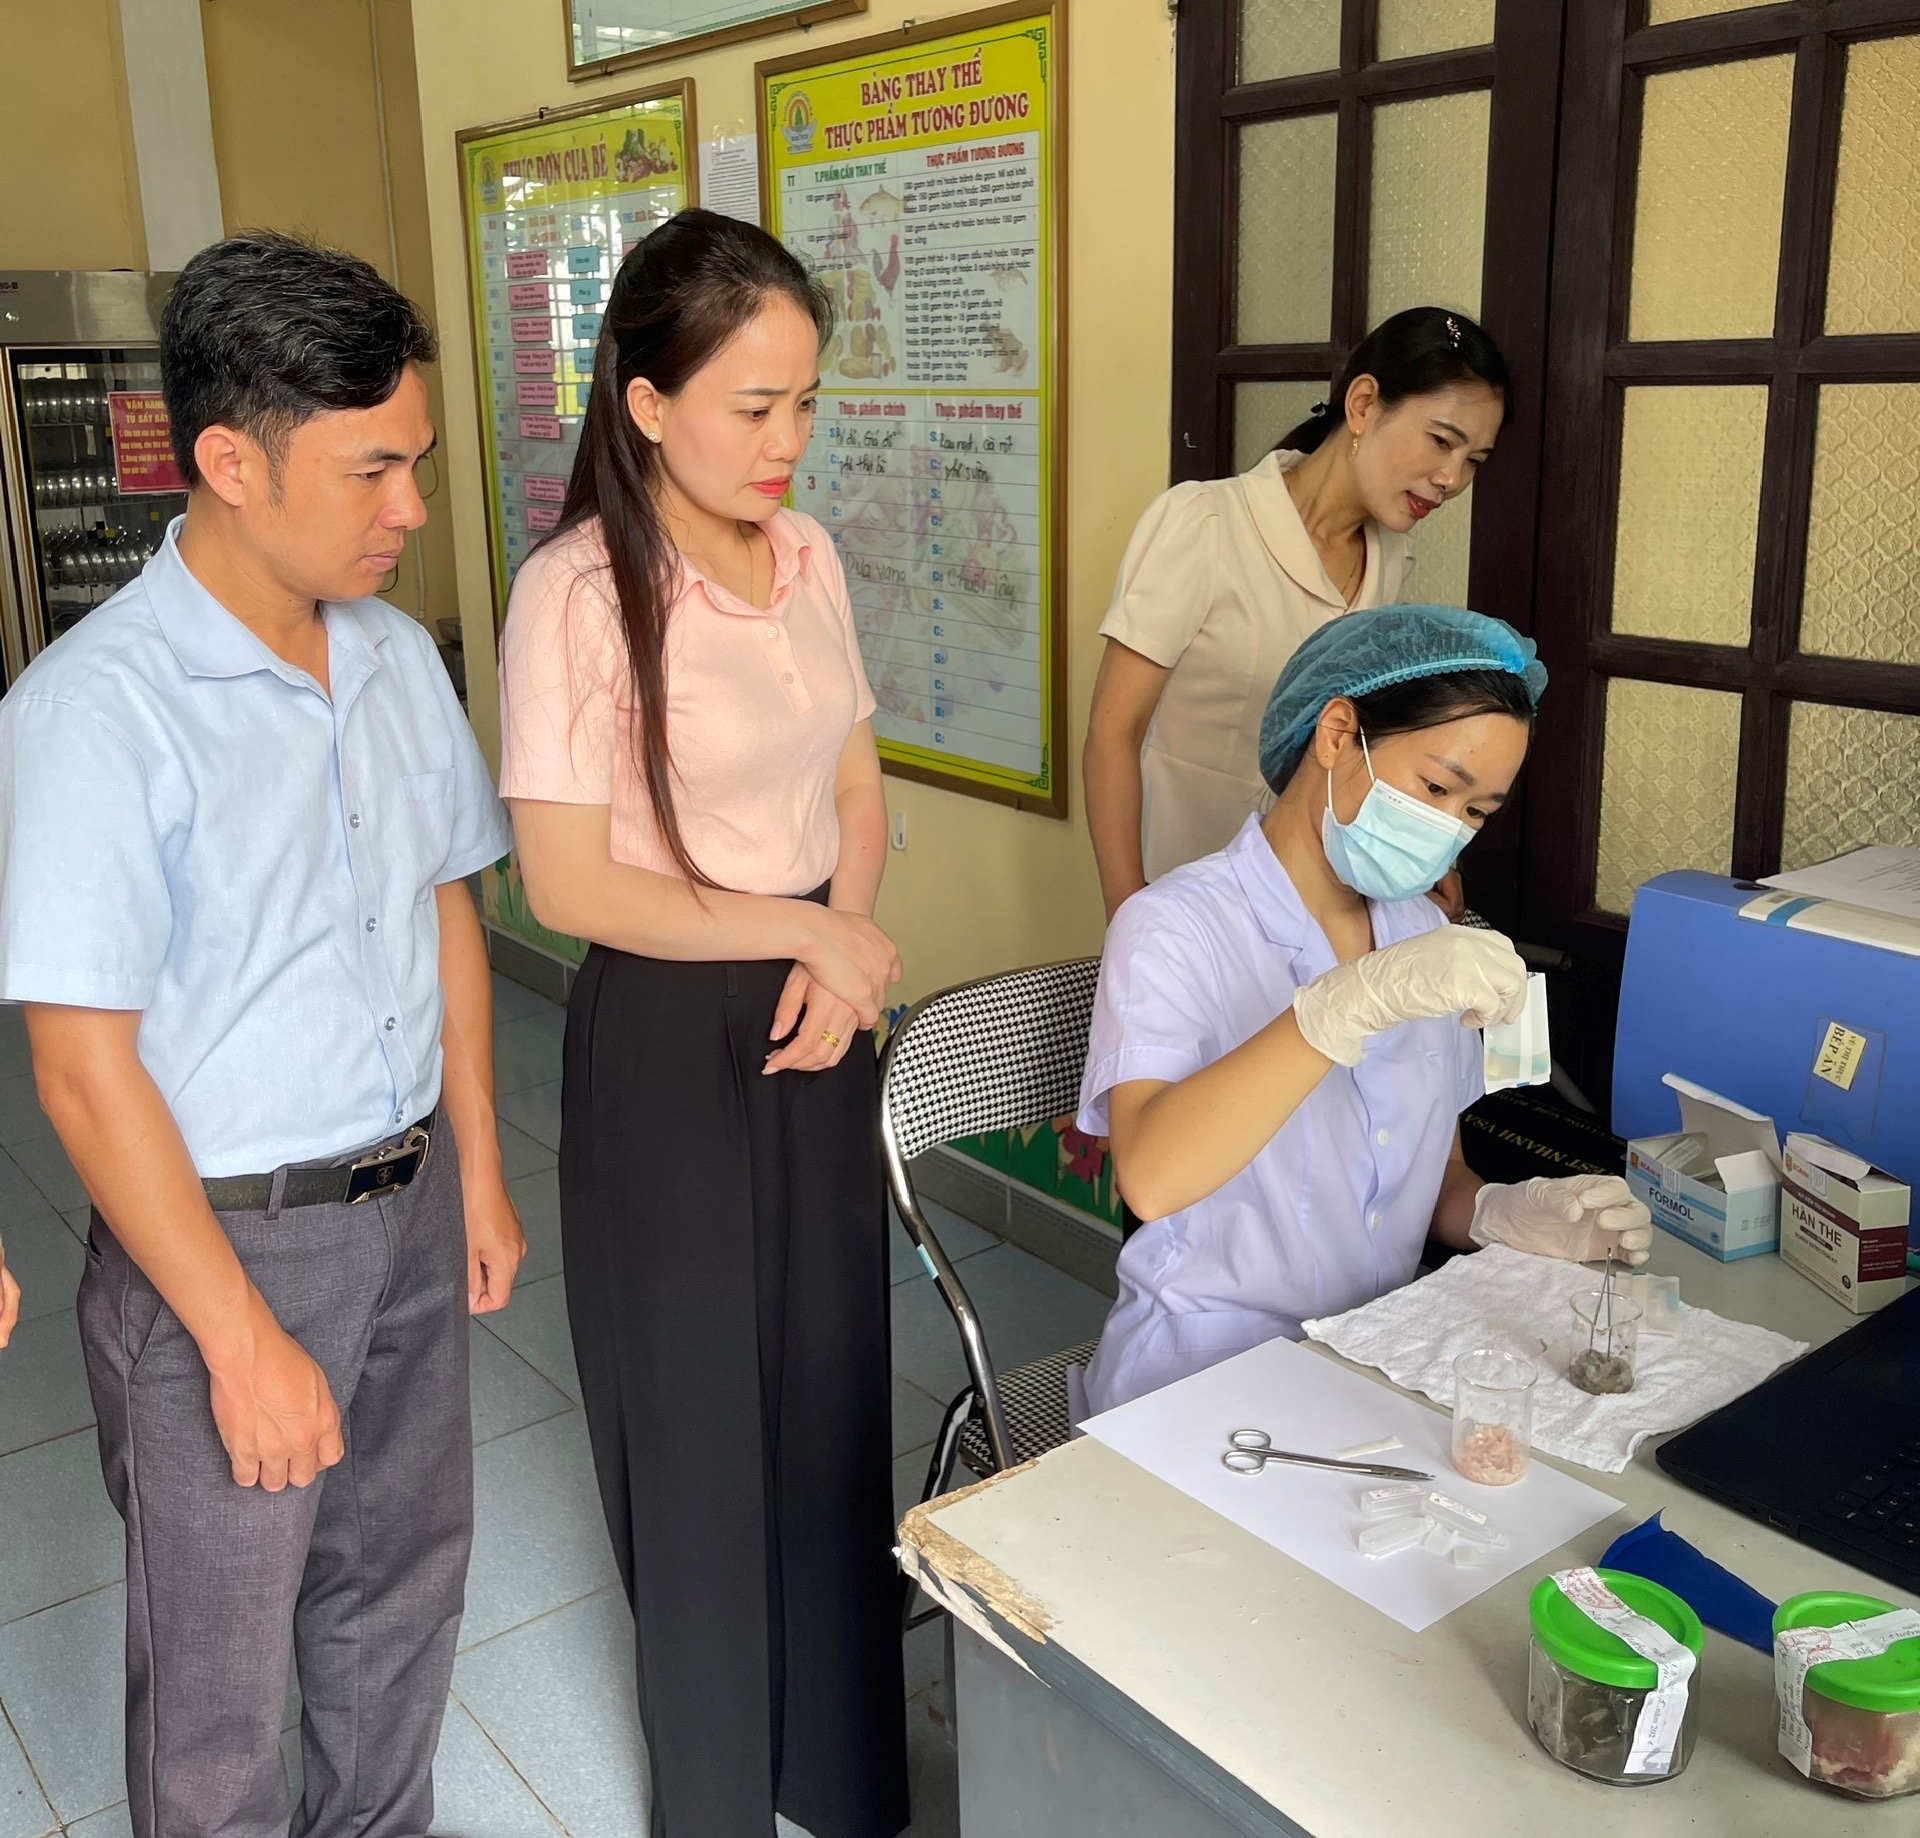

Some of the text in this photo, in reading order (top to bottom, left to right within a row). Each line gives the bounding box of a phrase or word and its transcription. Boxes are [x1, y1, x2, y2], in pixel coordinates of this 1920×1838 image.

[861, 72, 901, 106] BẢNG
[905, 66, 947, 98] THAY
[825, 122, 862, 151] THỰC
[867, 103, 907, 143] PHẨM
[911, 103, 965, 134] TƯƠNG
[969, 92, 1029, 126] ĐƯƠNG
[592, 133, 608, 178] BÉ
[787, 175, 795, 186] TT
[808, 476, 816, 490] 3
[831, 481, 840, 491] S:
[931, 488, 941, 499] S:
[832, 506, 841, 517] C:
[931, 516, 942, 526] C:
[833, 533, 843, 544] S:
[932, 544, 942, 555] S:
[932, 572, 943, 582] C:
[932, 600, 943, 610] S:
[933, 626, 944, 637] C:
[934, 654, 945, 664] S:
[934, 680, 944, 690] C:
[934, 707, 945, 717] S:
[934, 733, 945, 744] C:
[1821, 1026, 1845, 1076] BẾP ĂN
[1498, 1128, 1567, 1163] NHANH
[1565, 1158, 1615, 1176] EST
[1649, 1187, 1694, 1220] FORMOL
[1819, 1220, 1842, 1247] THE
